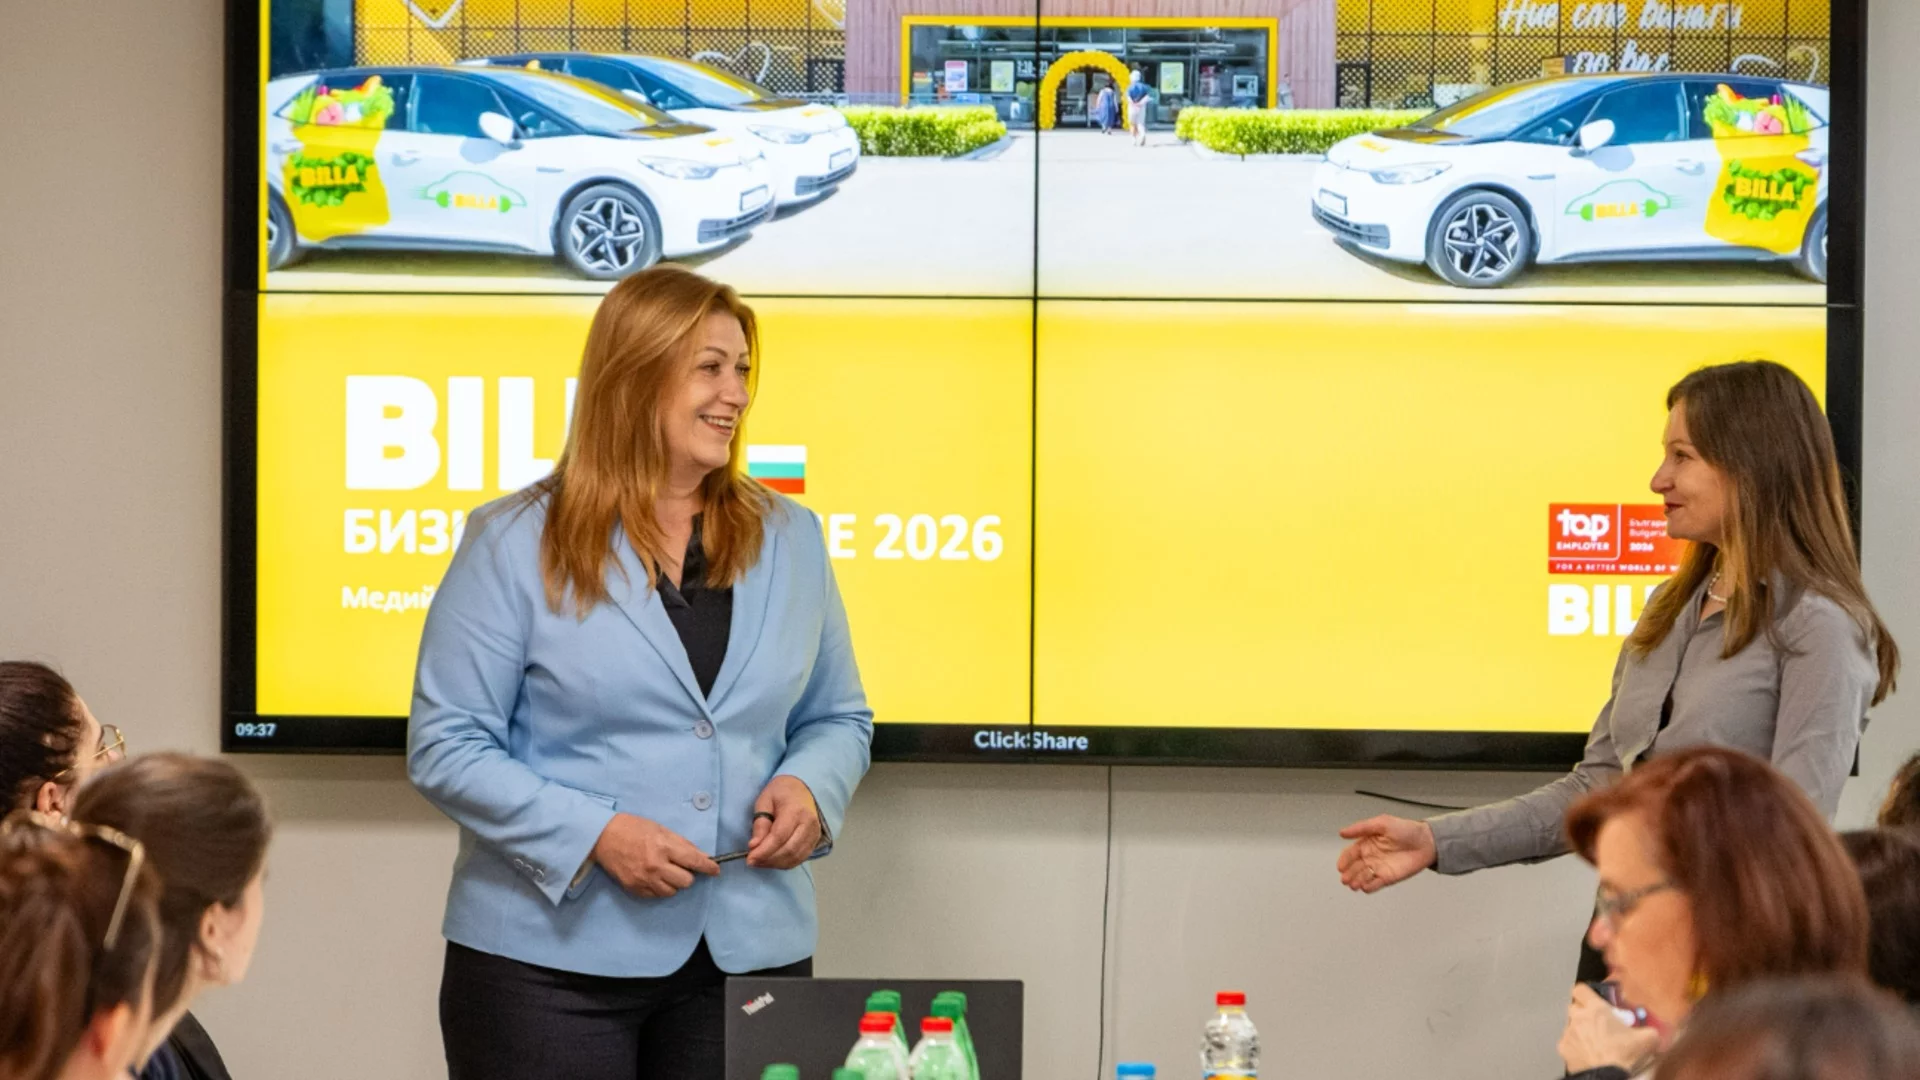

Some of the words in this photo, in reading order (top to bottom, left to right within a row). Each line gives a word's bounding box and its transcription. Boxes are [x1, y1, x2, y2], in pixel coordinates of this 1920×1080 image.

[300, 165, 360, 187] BILLA
[1735, 177, 1795, 201] BILLA
[454, 194, 497, 209] BILLA
[1595, 203, 1639, 218] BILLA
[345, 375, 578, 491] BIL
[1556, 508, 1610, 541] top
[873, 513, 1004, 561] 2026
[1556, 541, 1610, 551] EMPLOYER
[1556, 563, 1573, 571] FOR
[1576, 563, 1583, 571] A
[1585, 563, 1616, 571] BETTER
[1619, 564, 1651, 572] WORLD
[1654, 564, 1667, 572] OF
[1548, 584, 1656, 636] BIL
[235, 722, 276, 736] 09:37
[974, 730, 1089, 750] ClickShare
